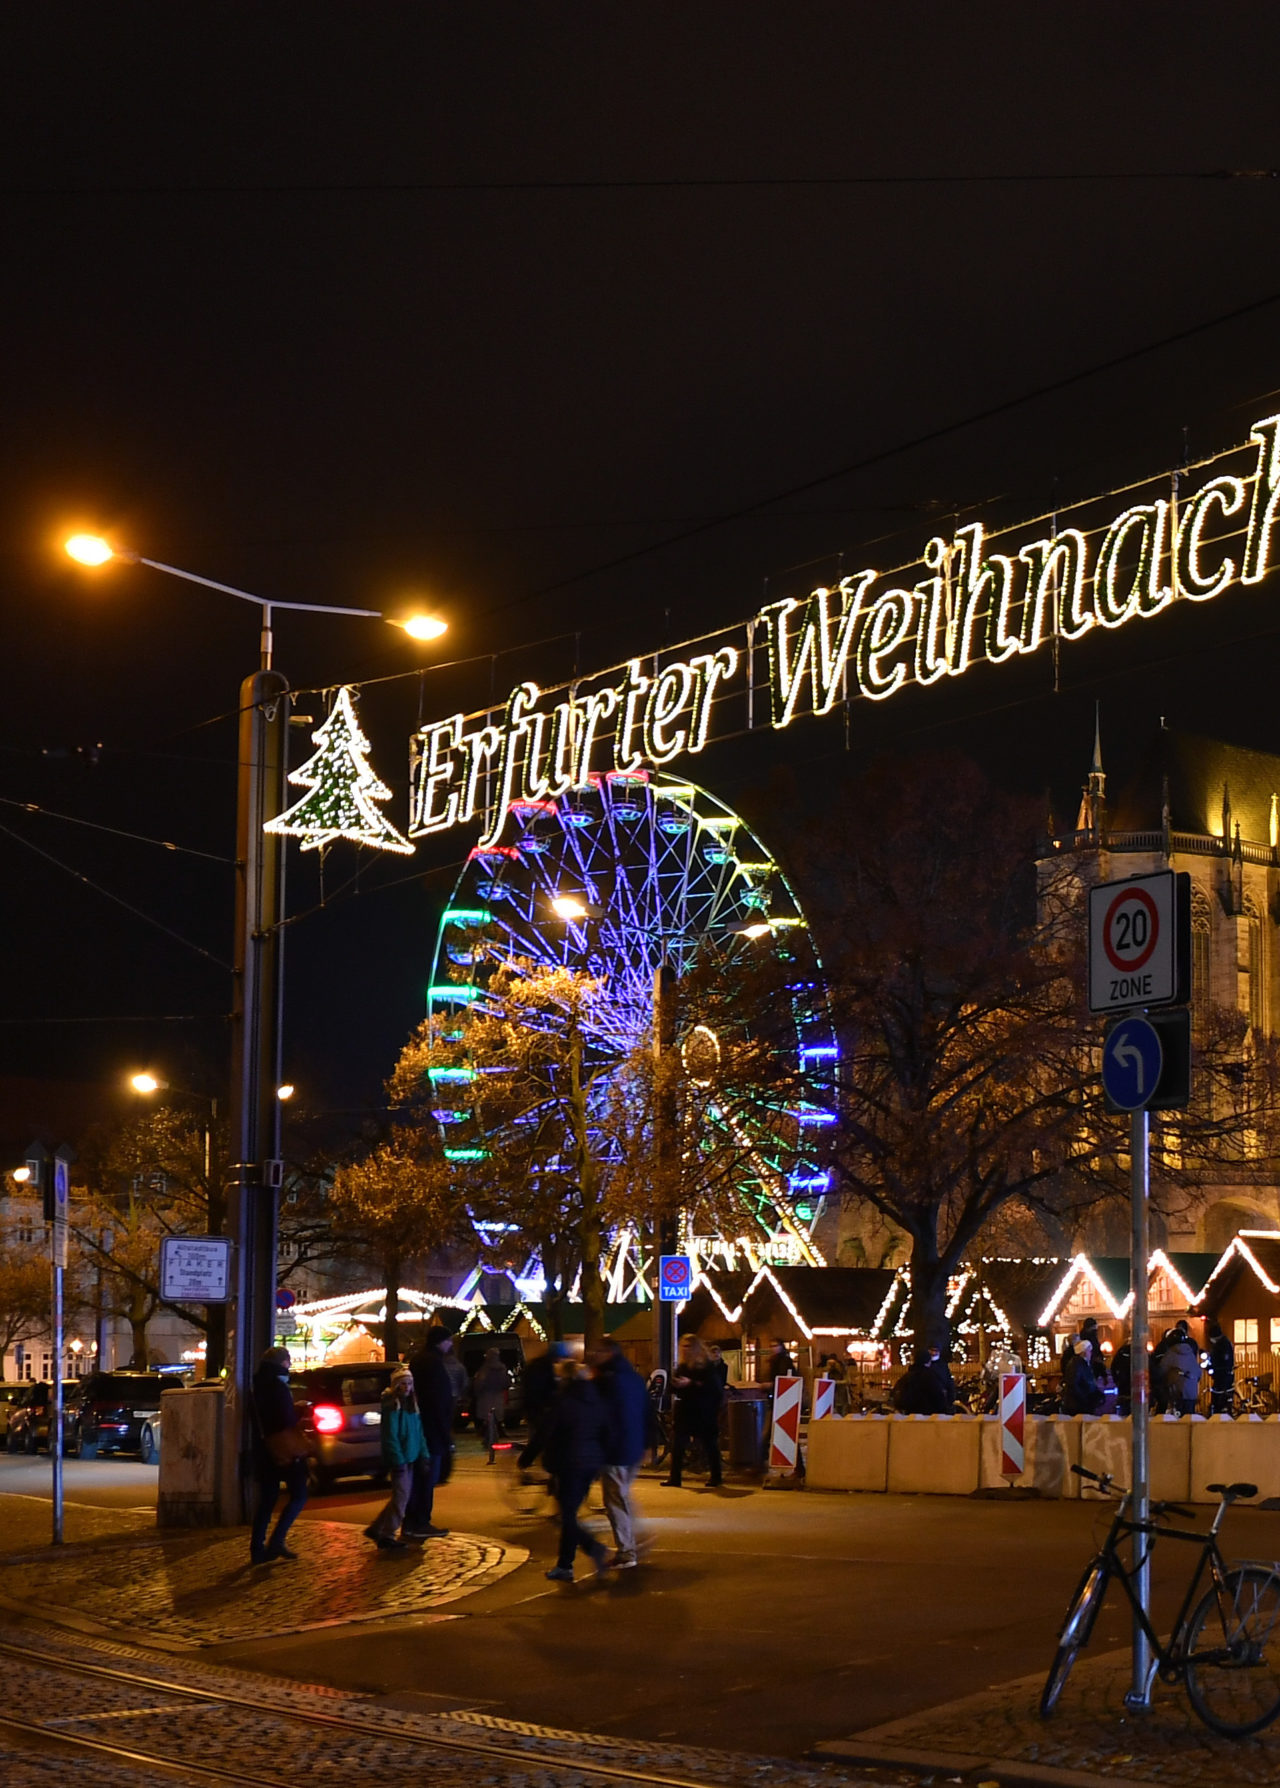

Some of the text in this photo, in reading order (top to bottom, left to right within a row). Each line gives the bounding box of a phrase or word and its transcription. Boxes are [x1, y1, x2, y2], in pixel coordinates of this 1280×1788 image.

[408, 647, 738, 849] Erfurter
[1115, 909, 1147, 951] 20
[1110, 975, 1152, 1001] ZONE
[663, 1286, 689, 1297] TAXI
